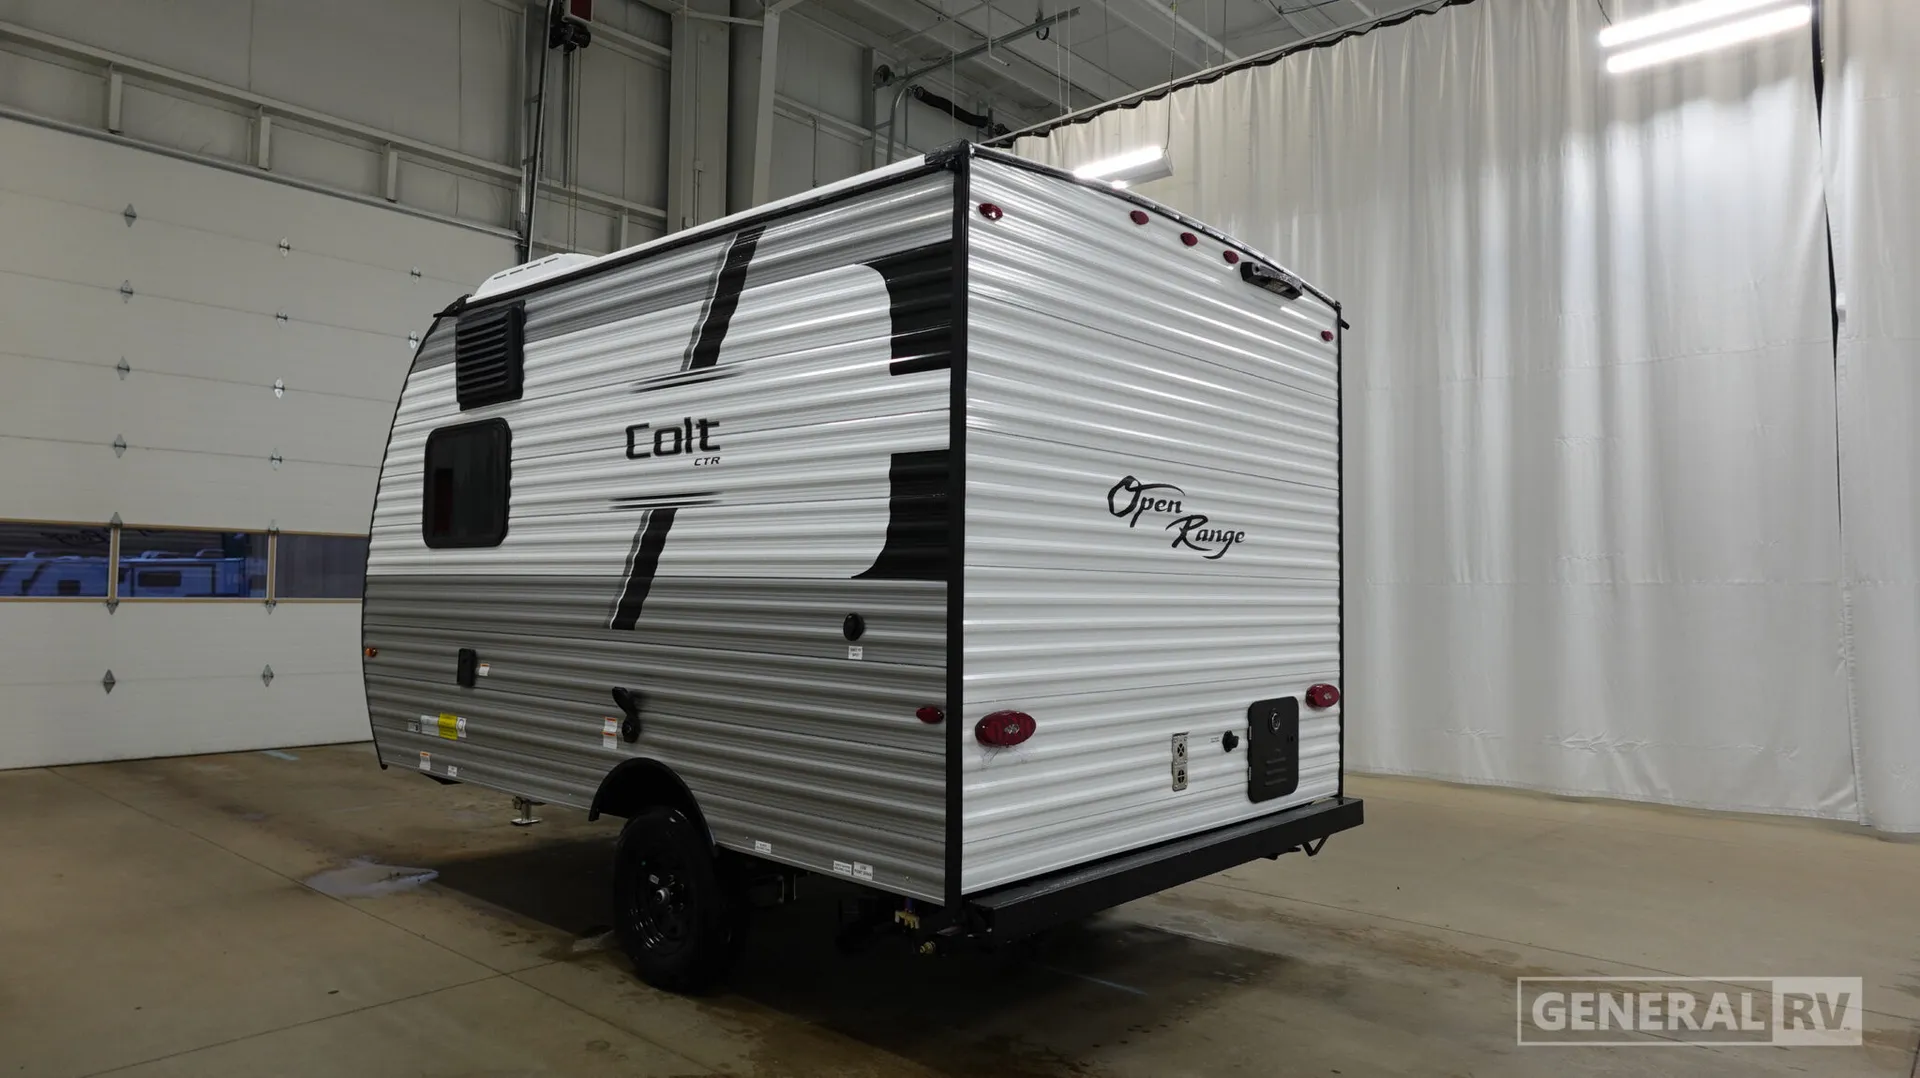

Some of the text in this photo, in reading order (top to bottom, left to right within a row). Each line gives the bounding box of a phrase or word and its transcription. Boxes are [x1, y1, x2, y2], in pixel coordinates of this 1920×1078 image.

[625, 416, 720, 460] Colt
[694, 457, 720, 466] CTR
[1107, 475, 1186, 528] Open
[1165, 514, 1246, 560] Range
